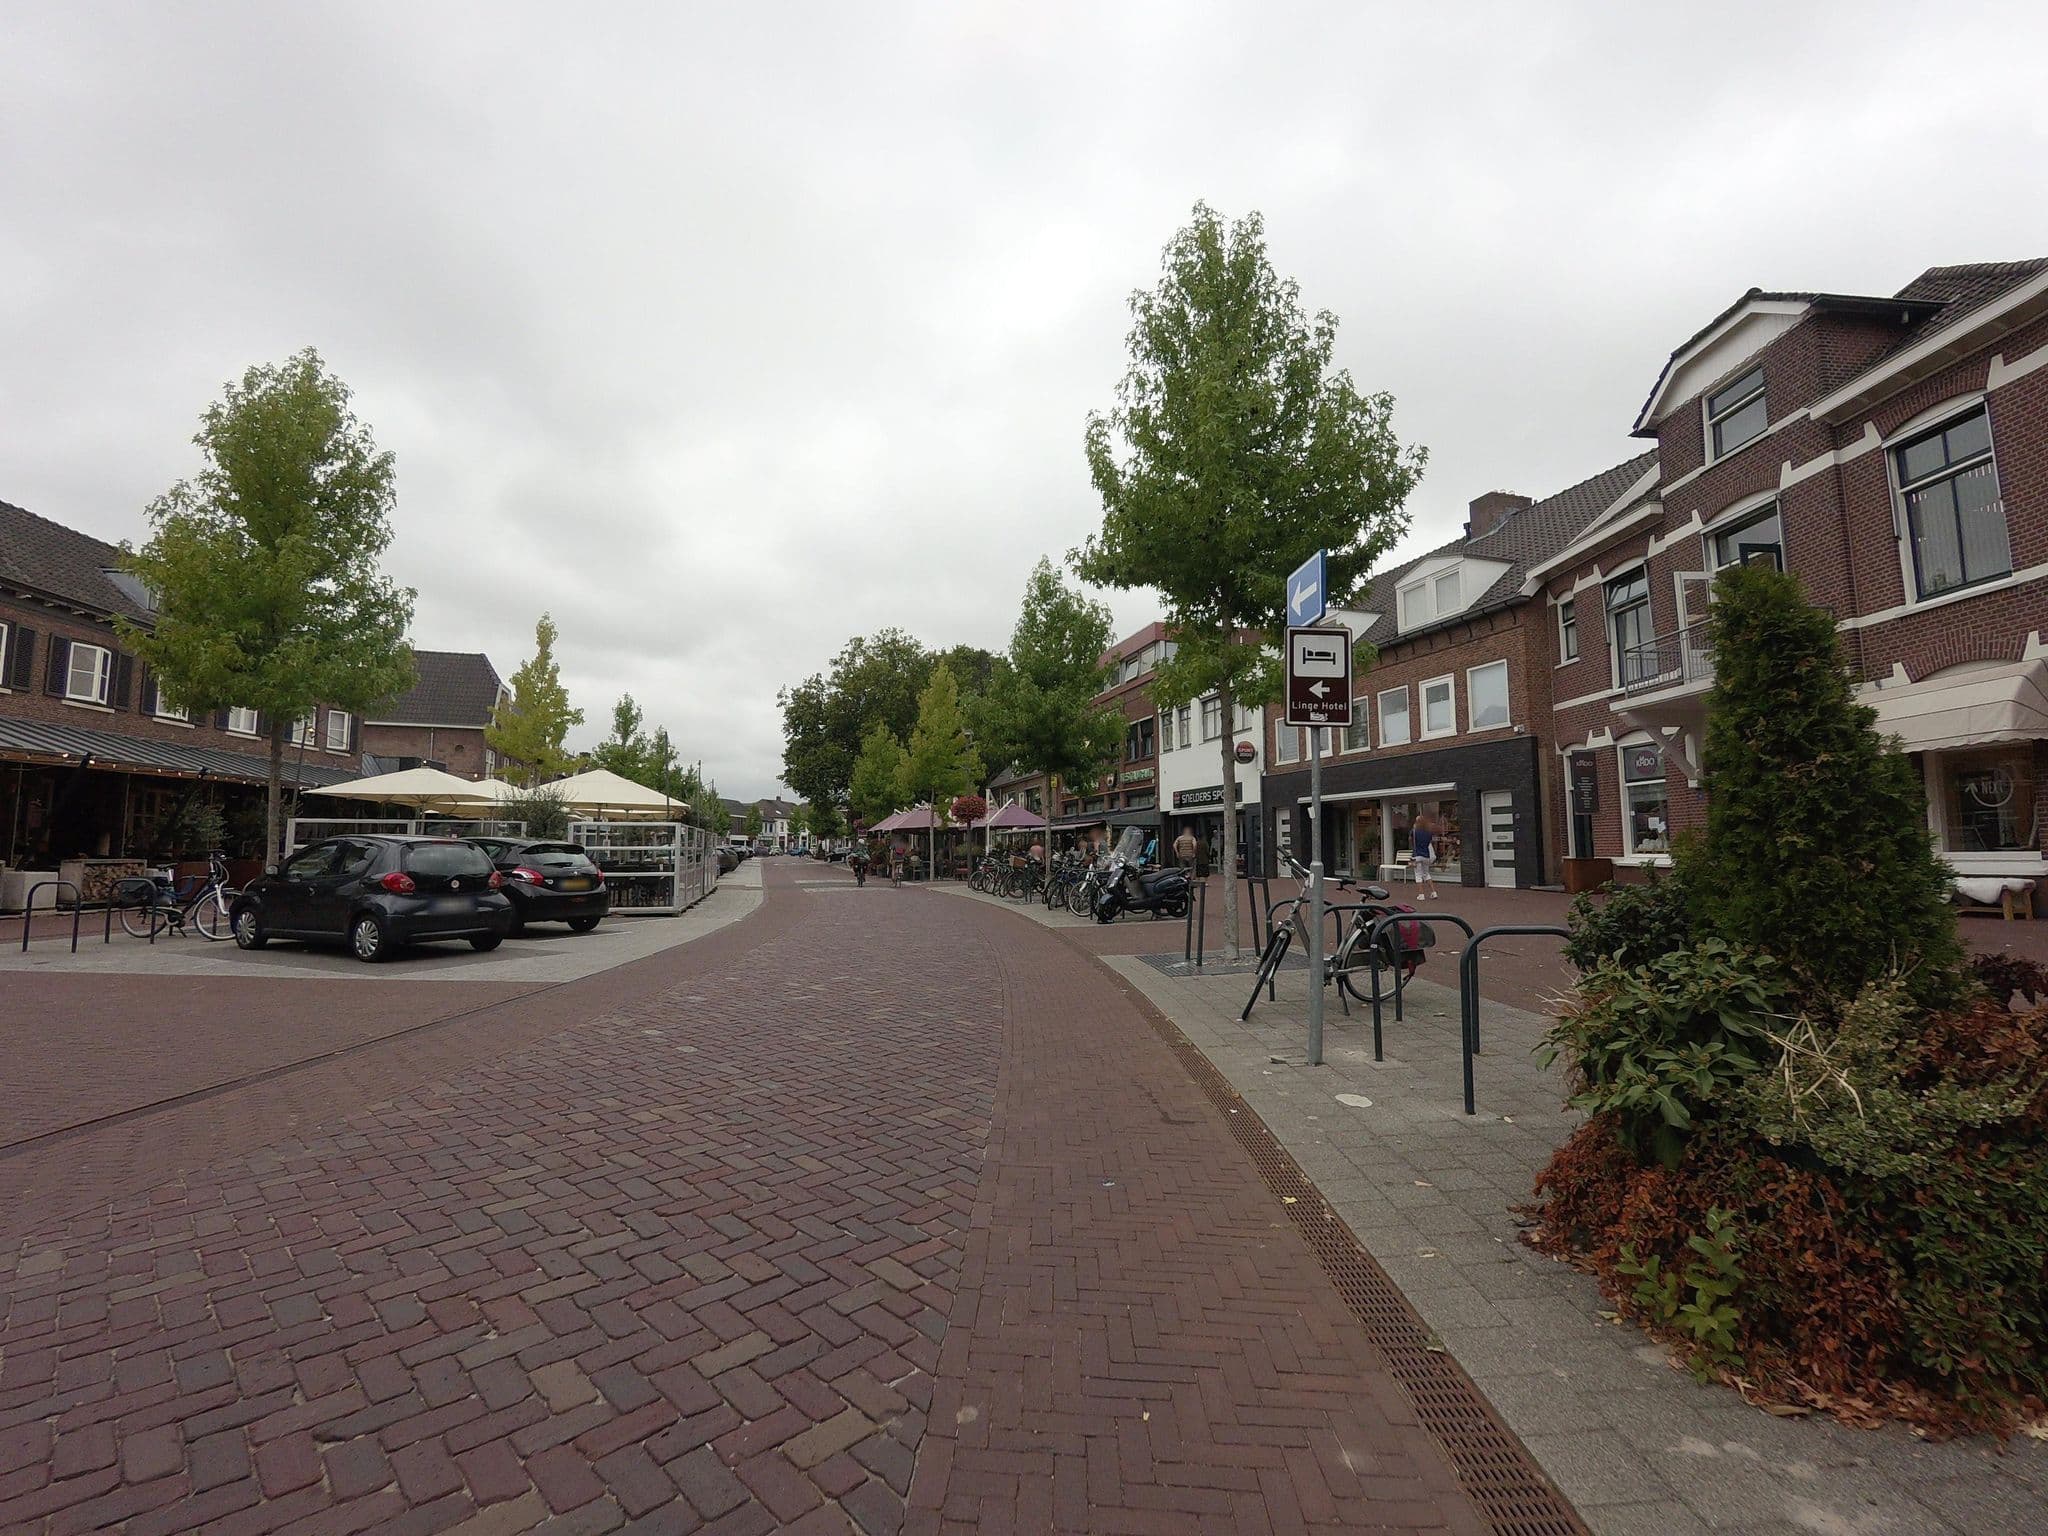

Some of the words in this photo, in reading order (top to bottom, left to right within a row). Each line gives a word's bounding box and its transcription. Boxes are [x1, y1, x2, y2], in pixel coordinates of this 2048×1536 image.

[1292, 701, 1319, 711] Linge
[1321, 702, 1347, 710] Hotel
[1182, 791, 1212, 804] SNELDERS
